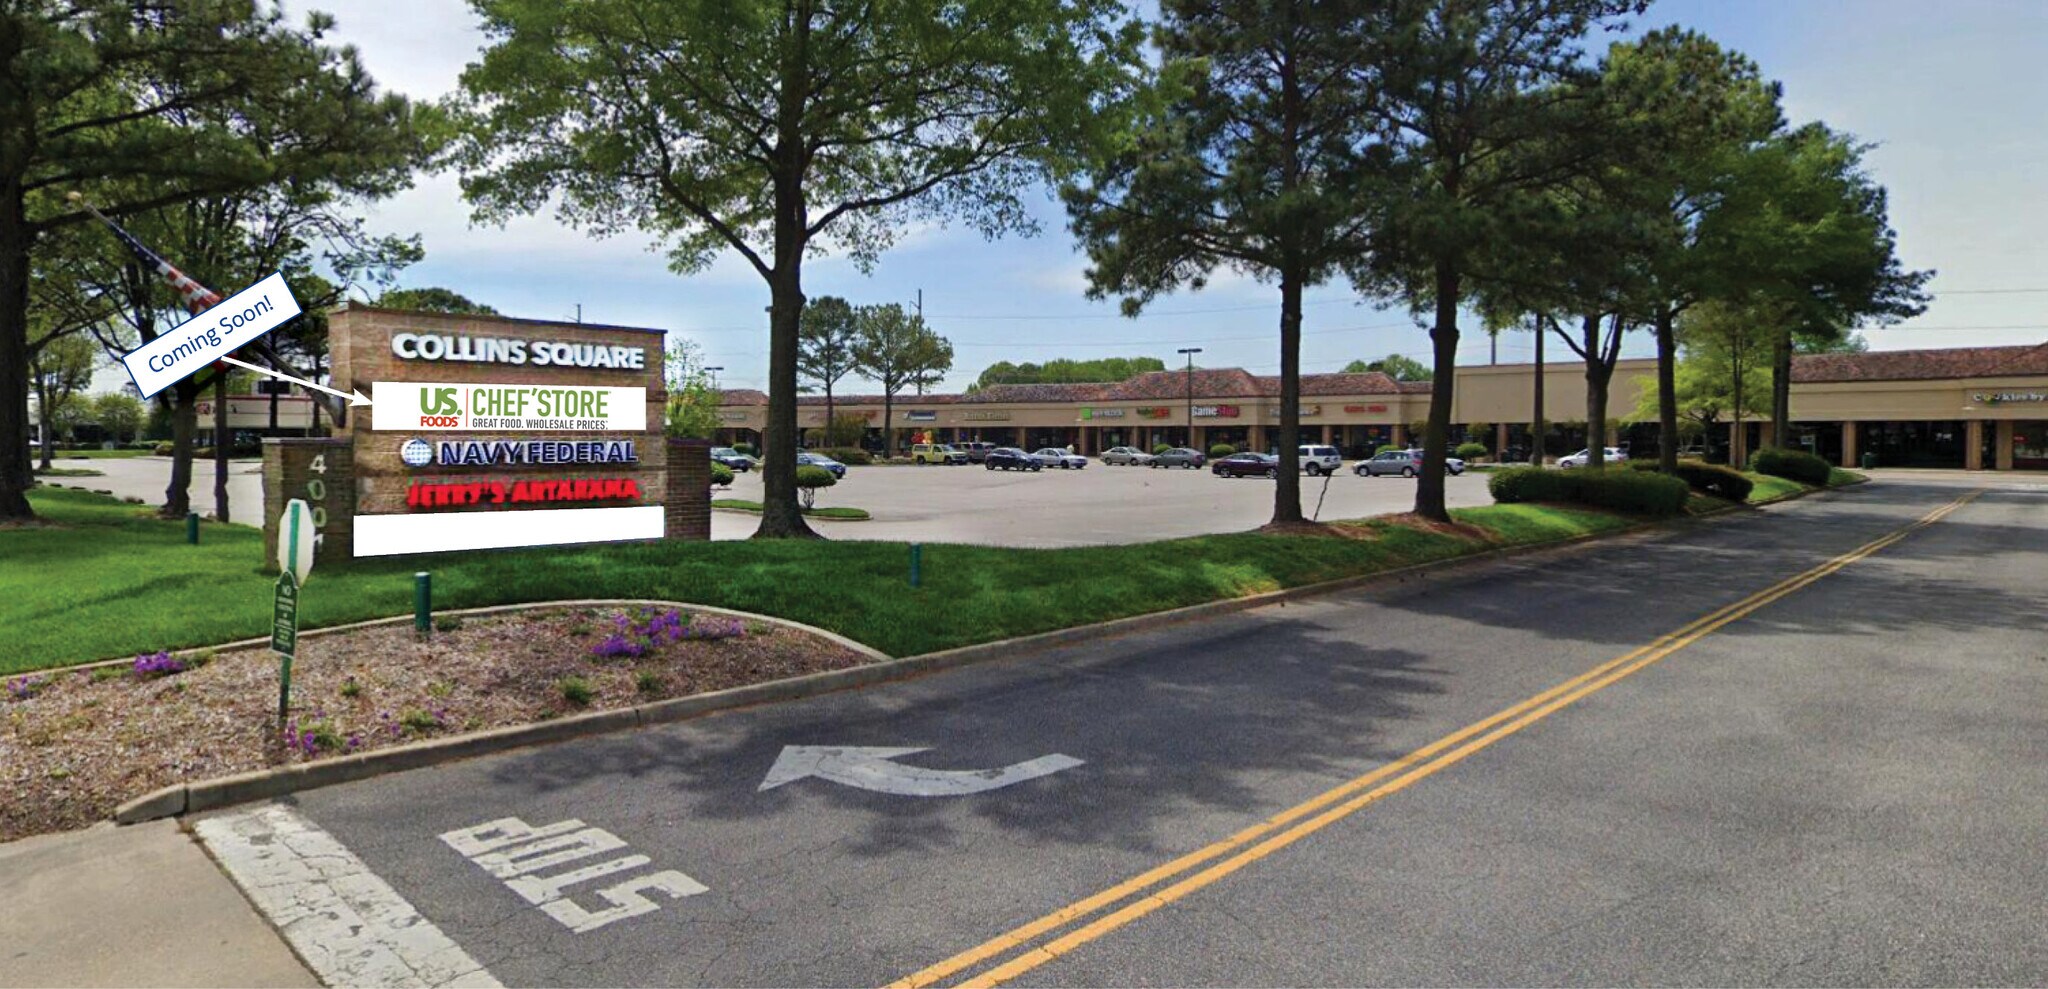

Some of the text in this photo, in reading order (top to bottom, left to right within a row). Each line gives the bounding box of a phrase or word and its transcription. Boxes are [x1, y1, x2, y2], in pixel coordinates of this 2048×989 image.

[391, 333, 644, 369] COLLINS SQUARE
[420, 387, 462, 416] US.
[420, 416, 459, 428] FOODS
[472, 418, 497, 428] GREAT
[500, 418, 524, 429] FOOD.
[526, 419, 574, 430] WHOLESALE
[437, 440, 639, 465] NAVY FEDERAL
[437, 816, 710, 934] STOP
